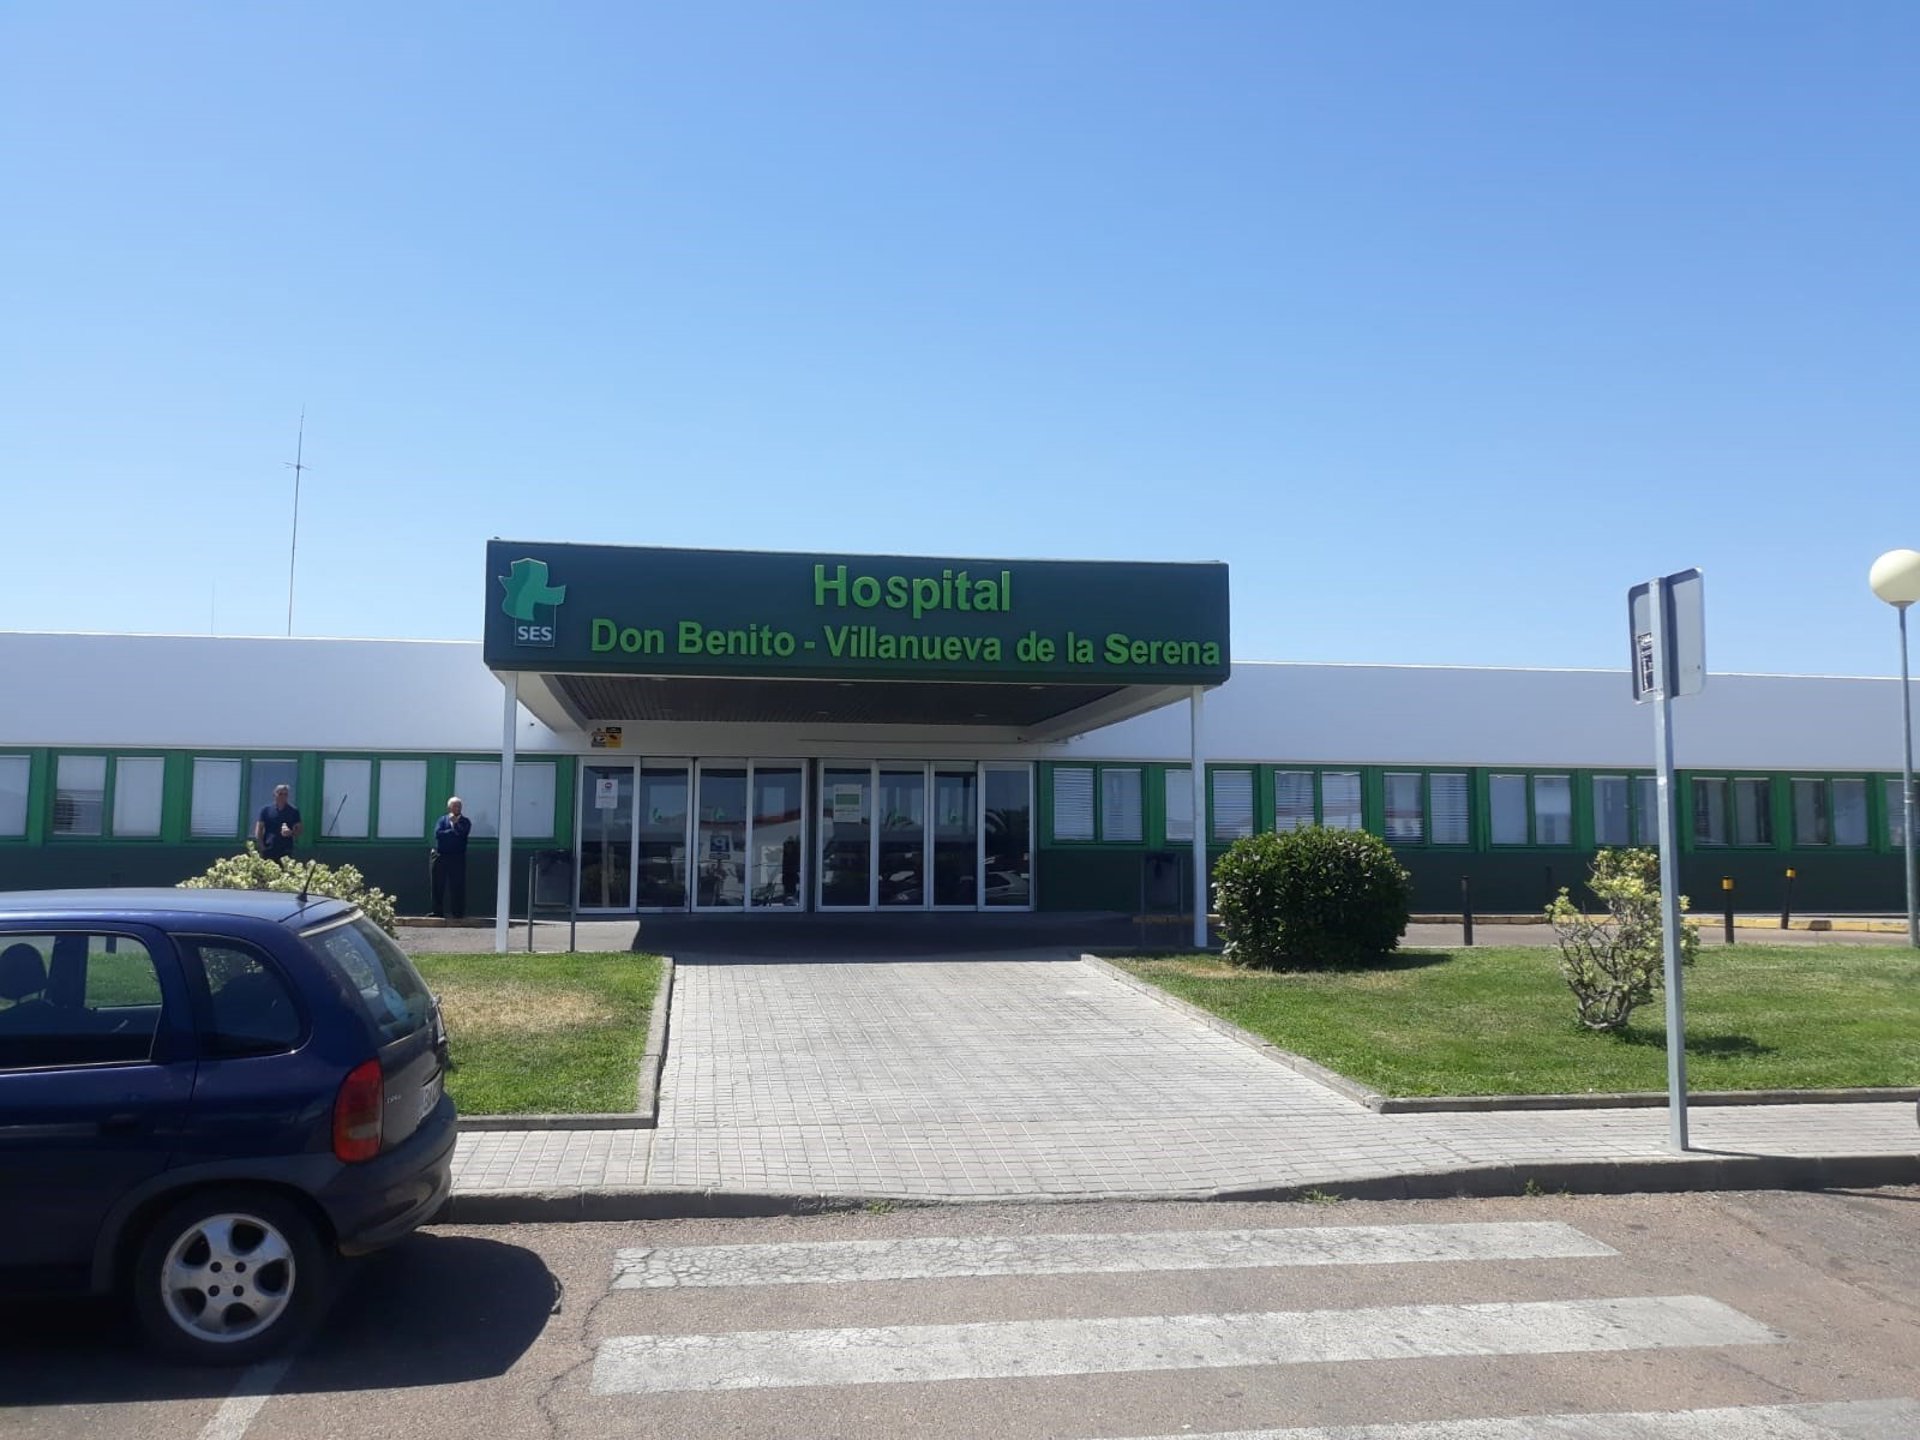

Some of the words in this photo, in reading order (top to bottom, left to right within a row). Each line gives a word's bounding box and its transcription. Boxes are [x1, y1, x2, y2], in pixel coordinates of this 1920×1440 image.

[814, 564, 1011, 620] Hospital
[518, 626, 552, 641] SES
[591, 618, 665, 654] Don
[678, 620, 796, 656] Benito
[824, 625, 1001, 661] Villanueva
[1016, 632, 1056, 662] de
[1067, 632, 1094, 663] la
[1104, 633, 1220, 665] Serena
